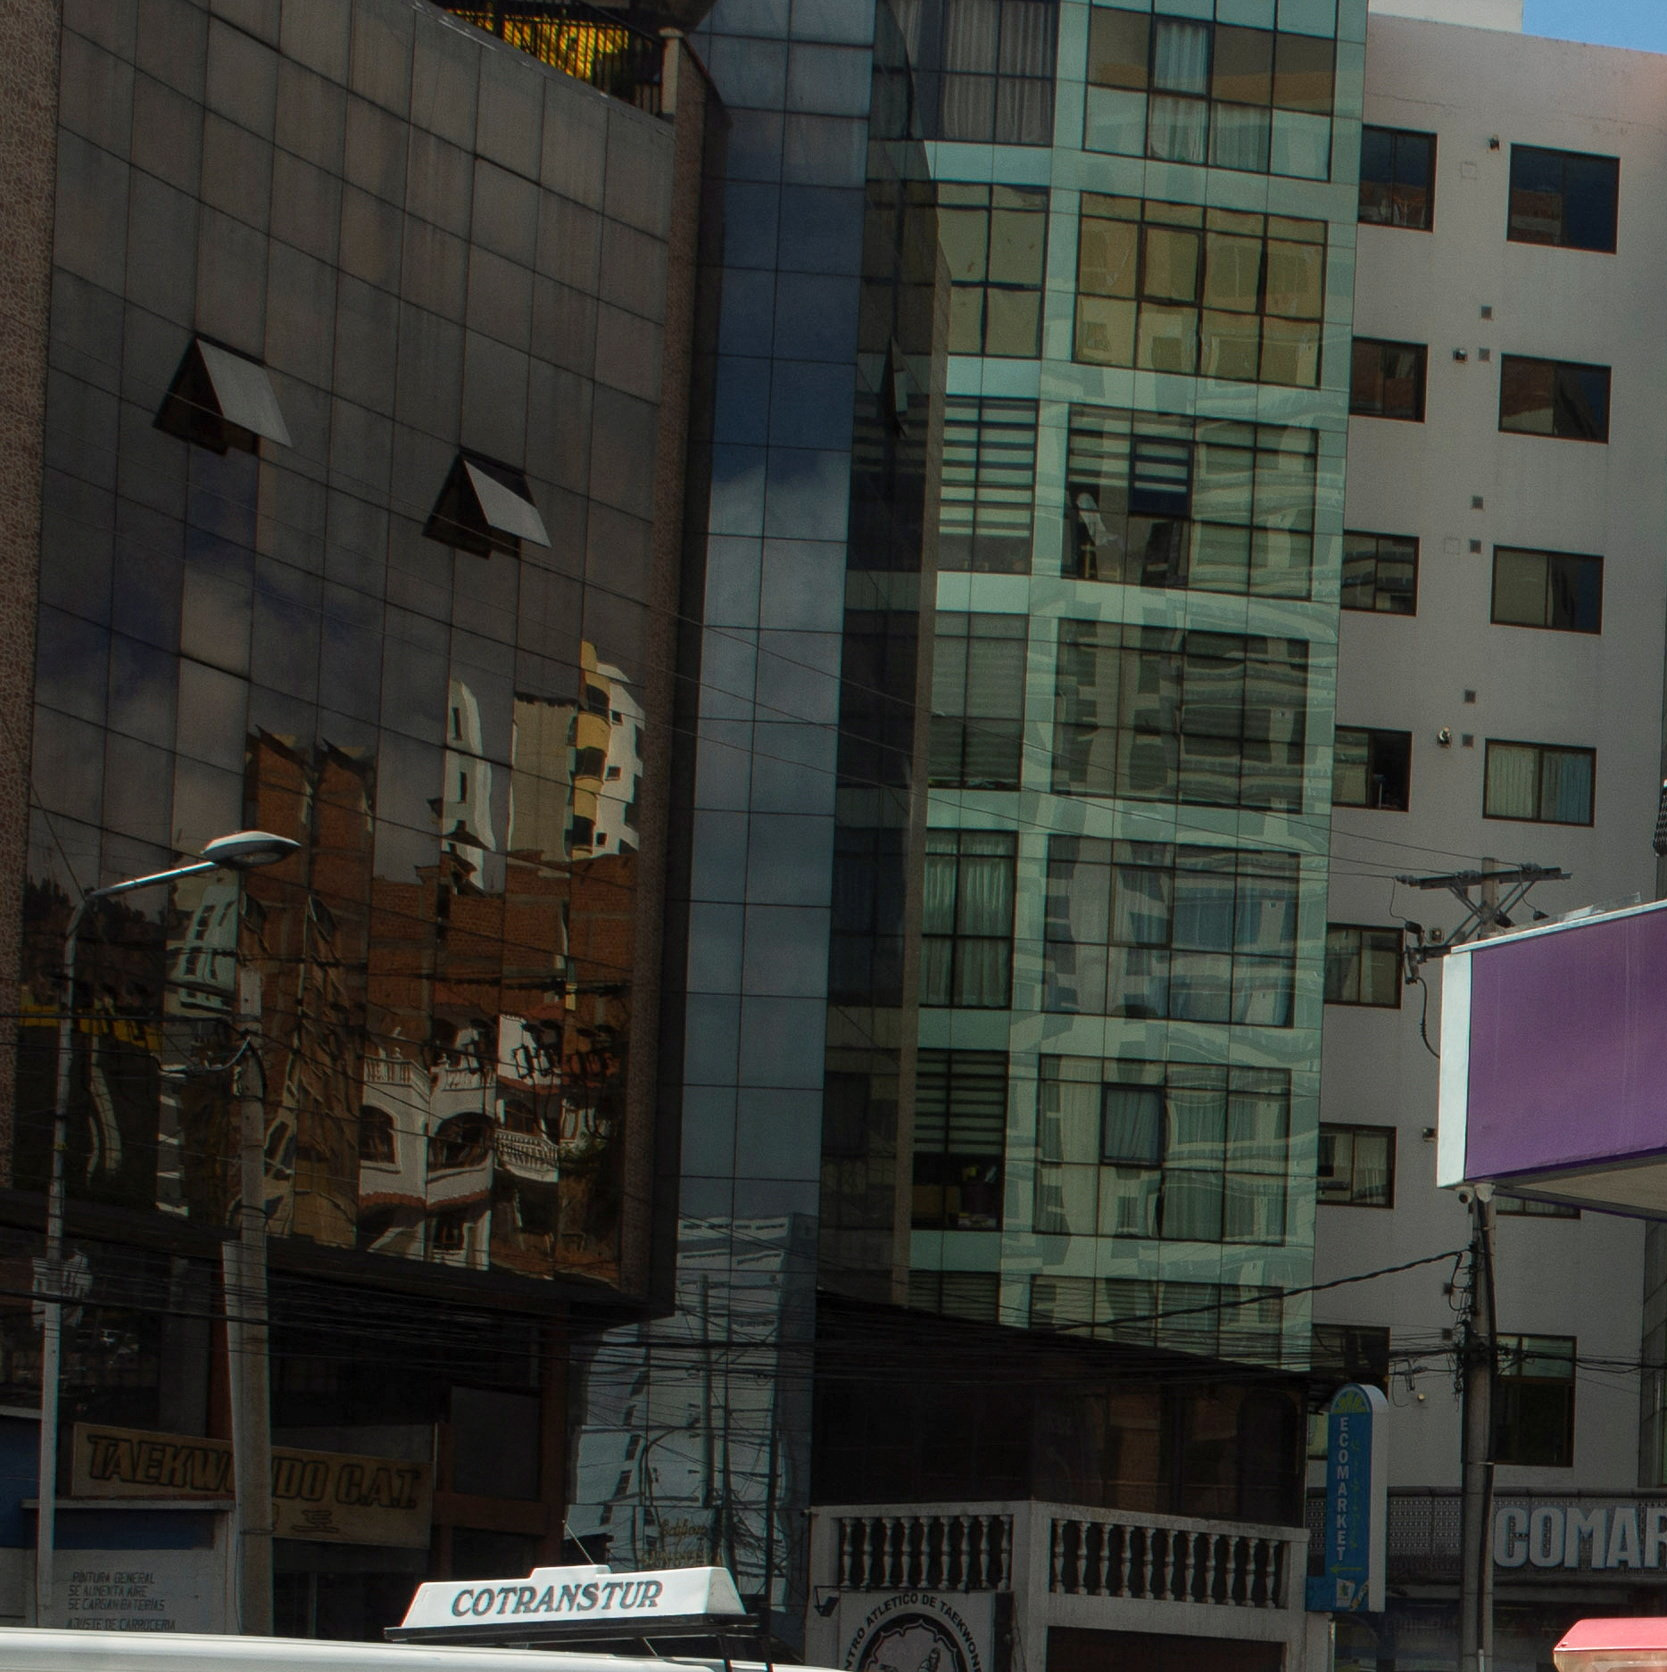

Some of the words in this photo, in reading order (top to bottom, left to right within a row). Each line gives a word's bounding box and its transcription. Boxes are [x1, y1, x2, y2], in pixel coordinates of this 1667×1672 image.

[87, 1434, 328, 1502] TAEKWDO
[1336, 1416, 1350, 1562] ECOMARKET
[114, 1571, 155, 1584] GENERAL
[451, 1580, 665, 1617] COTRANSTUR
[866, 1592, 918, 1627] ATLETICO
[921, 1593, 938, 1609] DE
